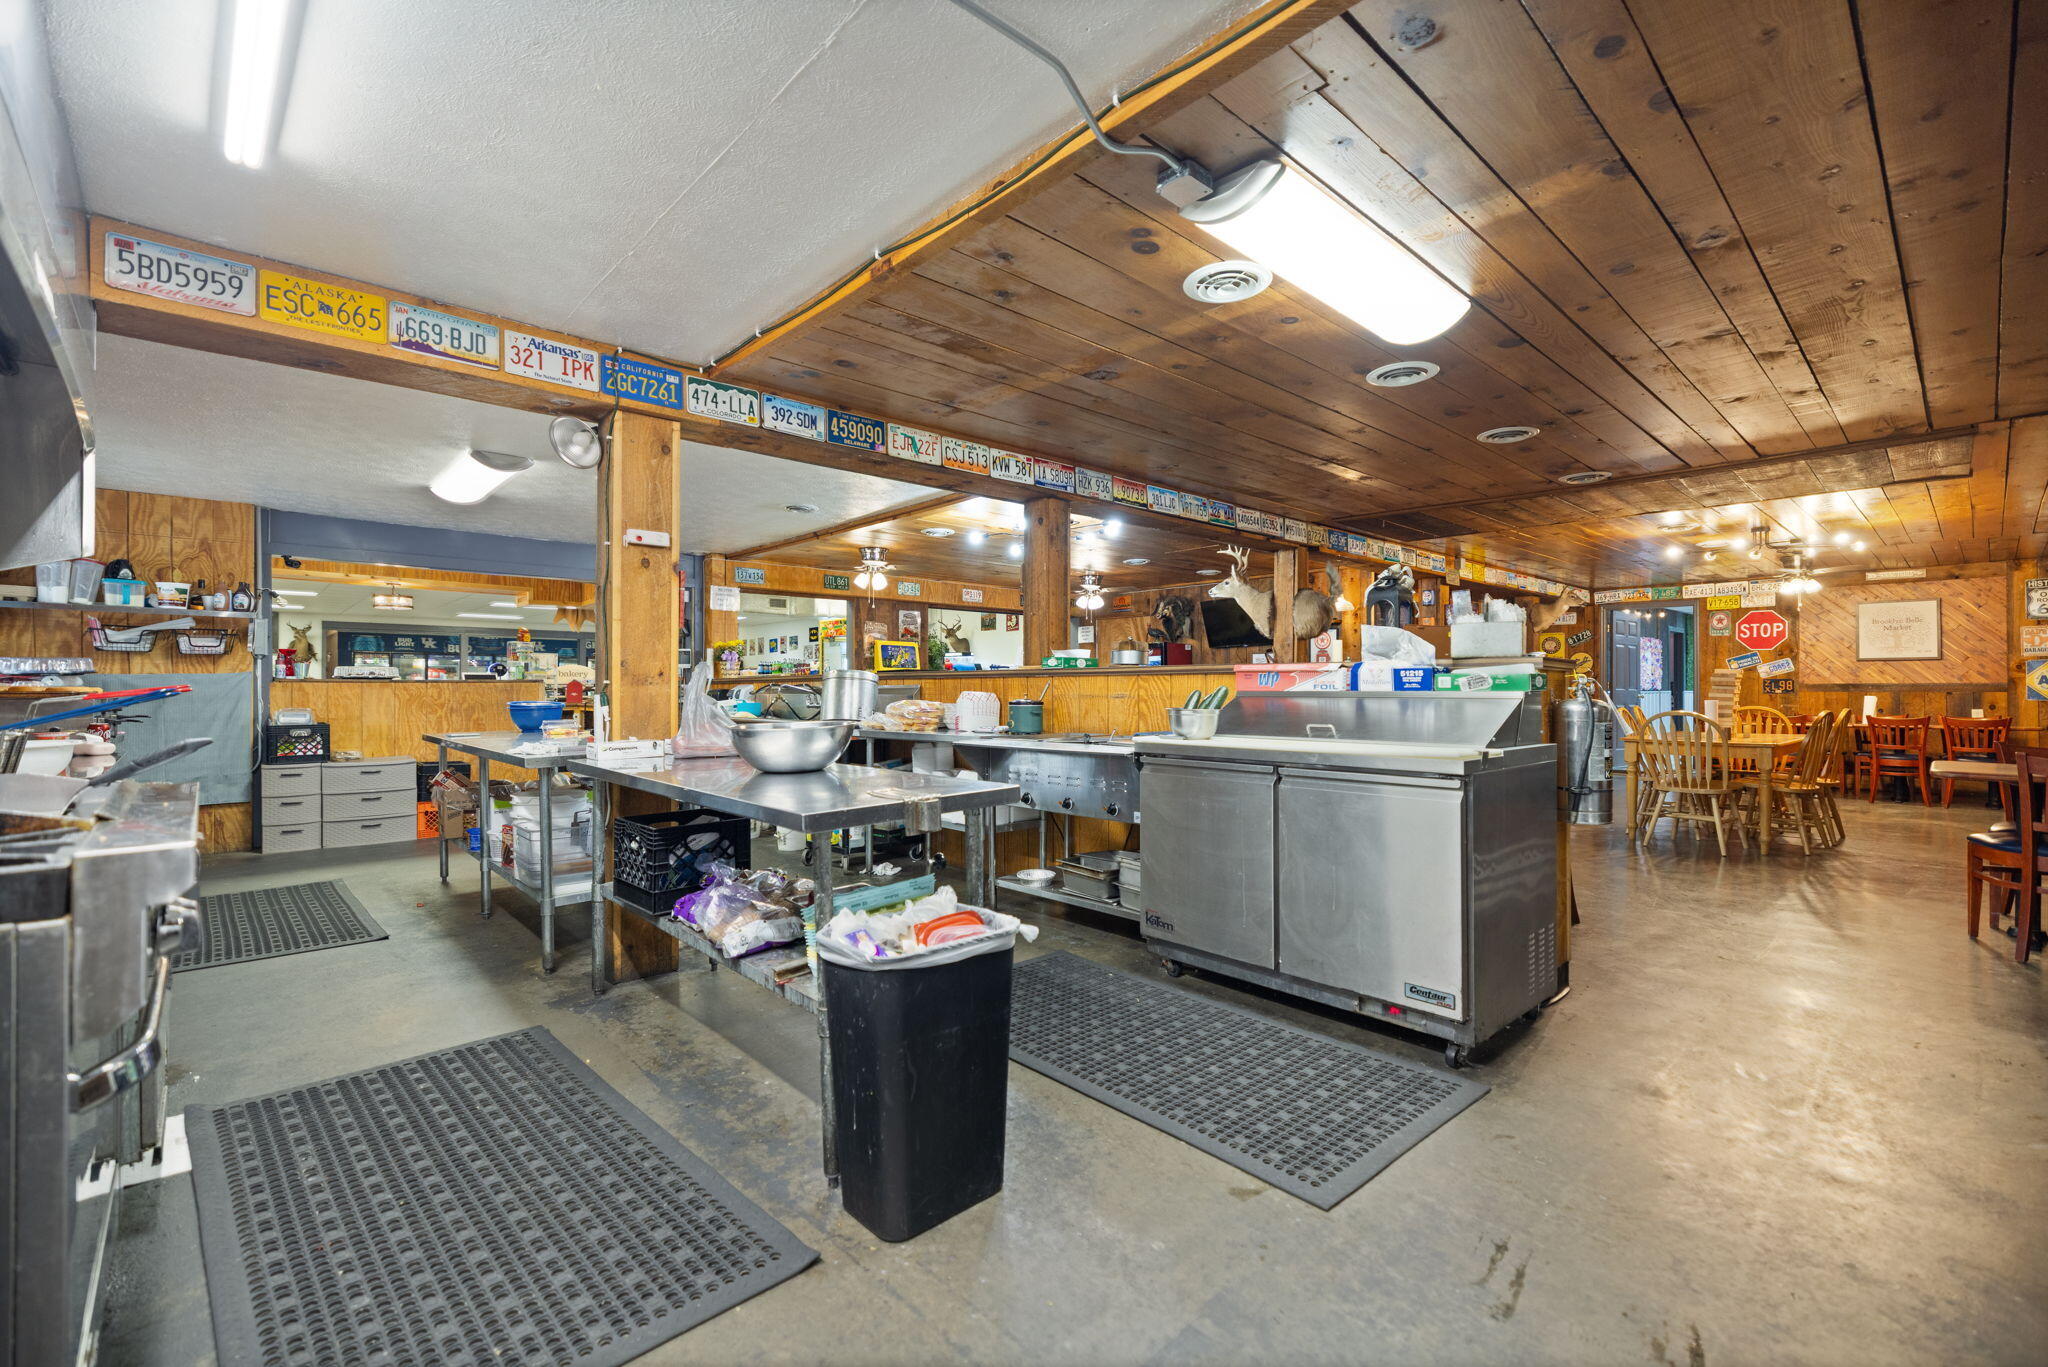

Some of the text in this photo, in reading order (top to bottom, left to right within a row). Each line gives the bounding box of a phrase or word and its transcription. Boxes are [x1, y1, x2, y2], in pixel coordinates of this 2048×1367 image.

[118, 248, 243, 298] 5BD5959
[292, 281, 356, 303] ALASKA
[266, 284, 381, 331] ESC 665
[527, 337, 580, 359] Arkansas
[510, 345, 543, 371] 321
[561, 356, 595, 382] IPK
[621, 363, 664, 379] CALIFORNIA
[606, 370, 678, 403] 2GC7261
[706, 408, 742, 420] COLORADO
[830, 417, 883, 445] 459090
[917, 439, 939, 457] 22F
[944, 446, 966, 464] CSJ
[968, 451, 989, 469] 513
[1015, 460, 1032, 478] 587
[1740, 622, 1784, 638] STOP
[558, 669, 589, 678] bakery
[1258, 672, 1280, 687] WP
[1400, 669, 1425, 677] 51215
[1145, 911, 1174, 931] KaTom
[1409, 985, 1447, 1001] Centaur
